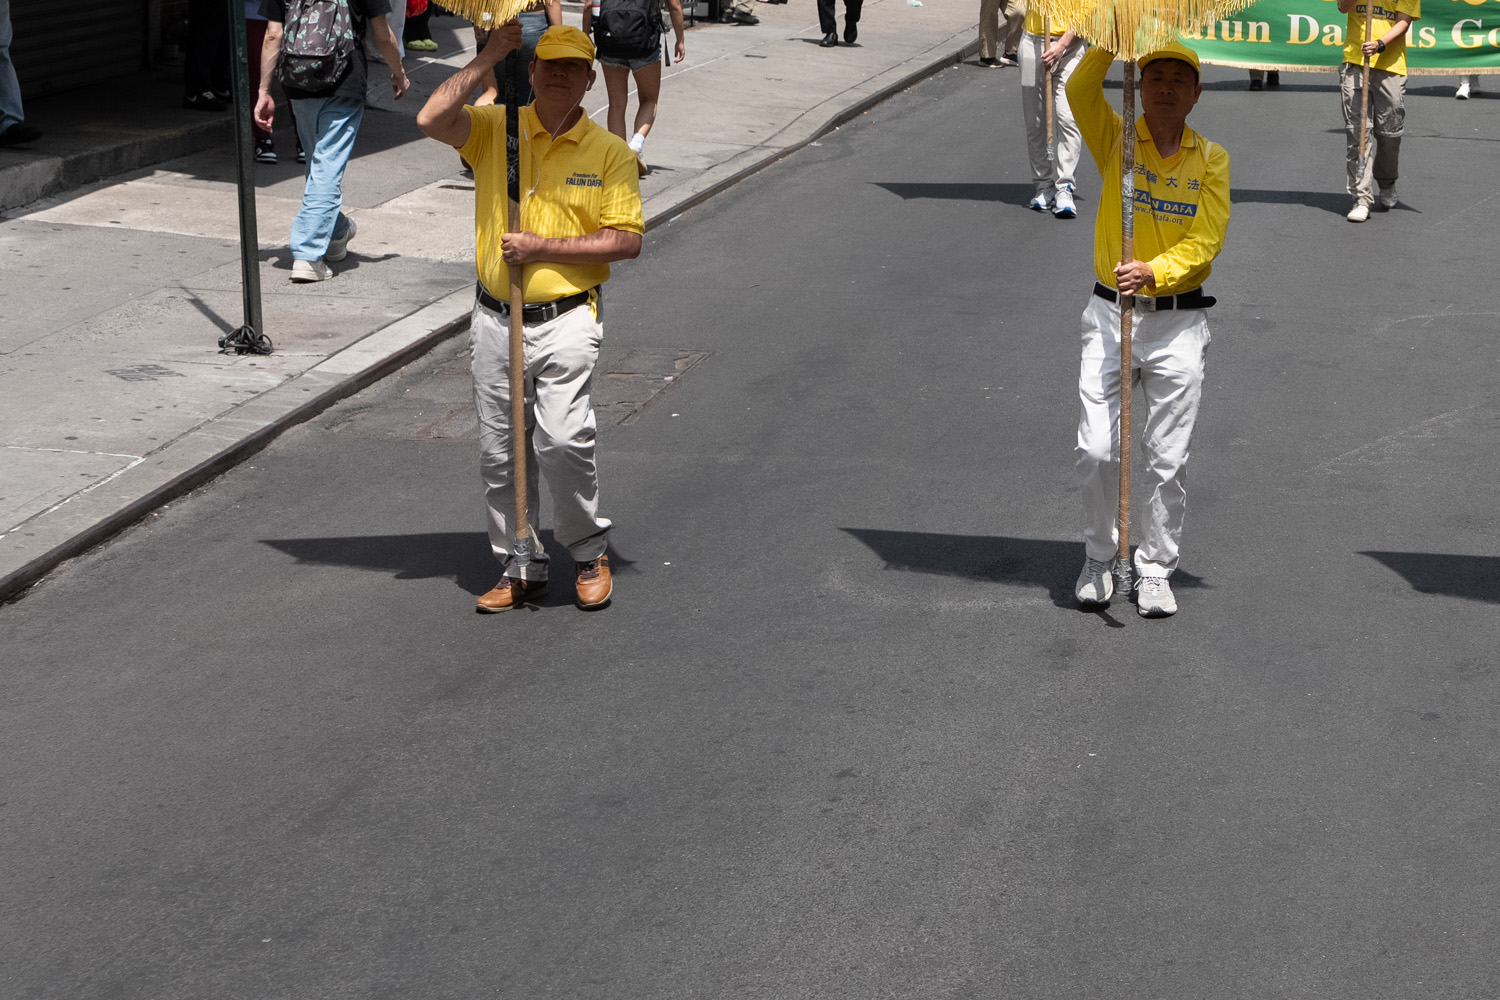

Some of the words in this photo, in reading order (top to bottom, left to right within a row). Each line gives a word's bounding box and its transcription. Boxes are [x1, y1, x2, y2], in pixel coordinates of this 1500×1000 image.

[1357, 6, 1380, 14] FAN
[1286, 13, 1346, 47] Da
[566, 177, 587, 187] FALUN
[587, 178, 603, 188] DAFA
[1134, 162, 1200, 191] 法輪大法
[1133, 191, 1159, 209] FAN
[1163, 202, 1194, 215] DAFA
